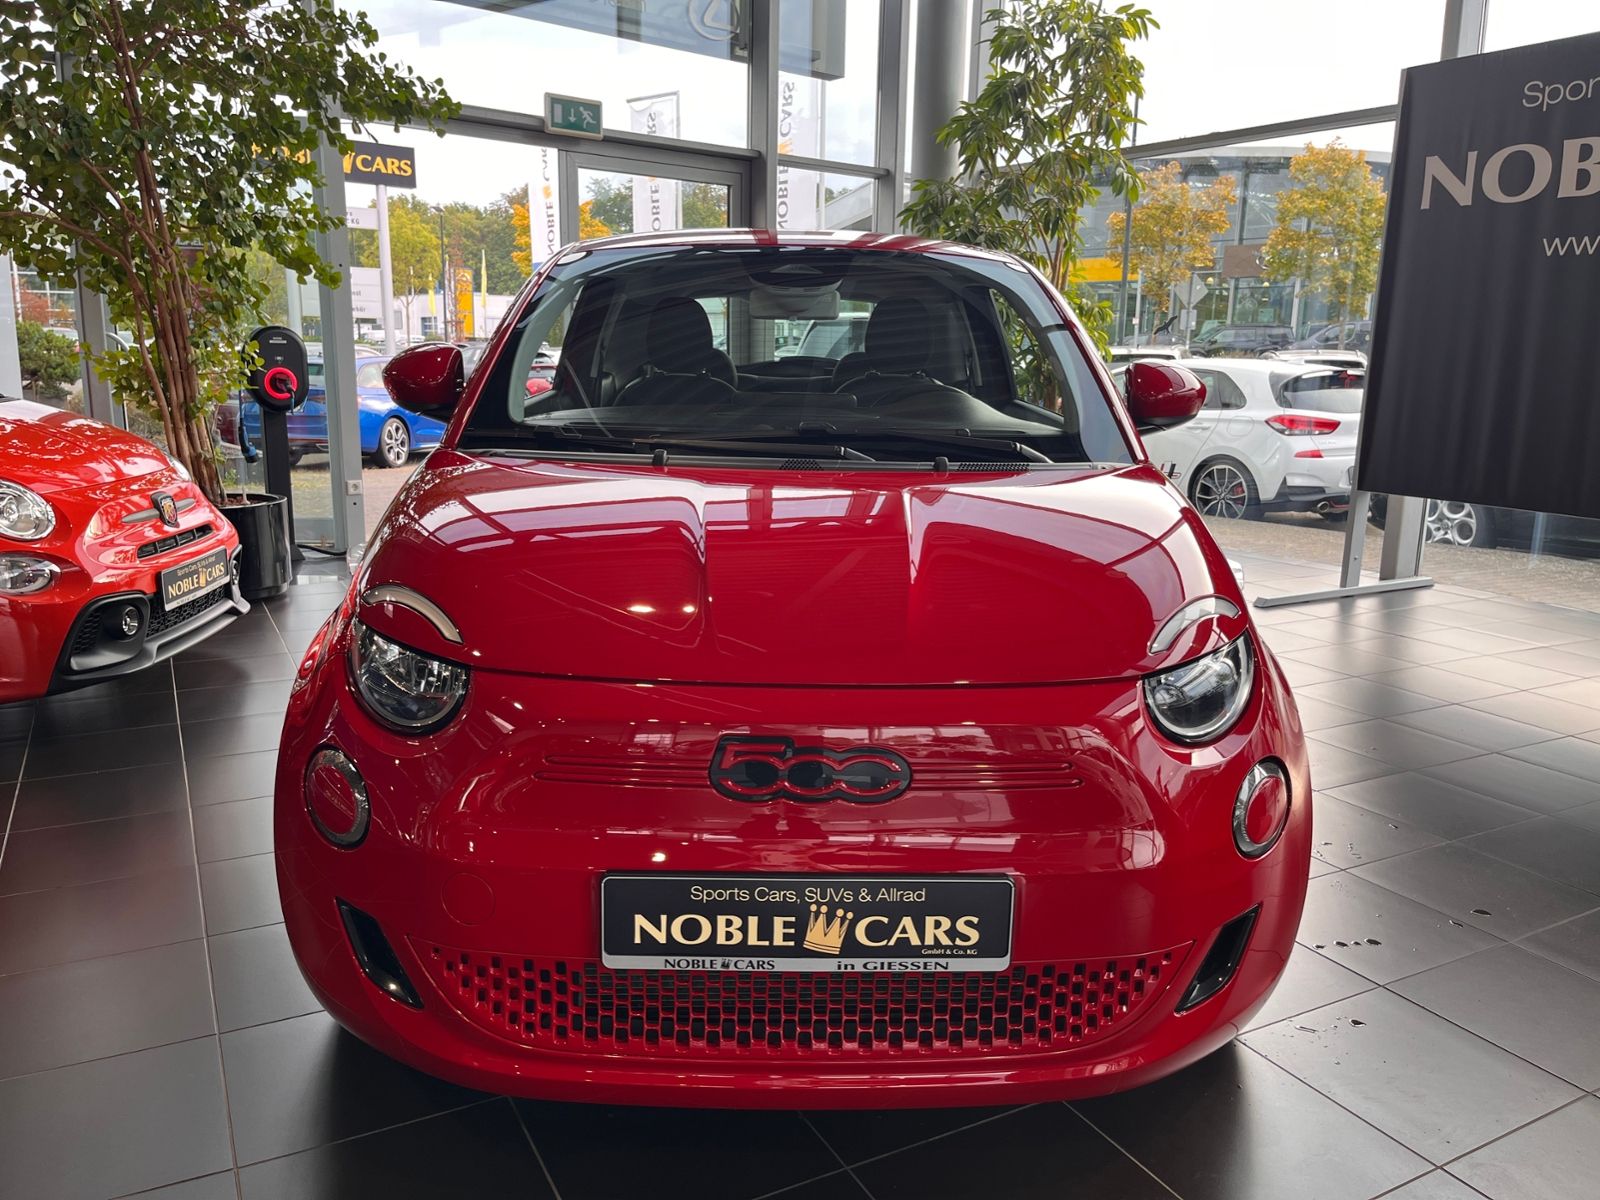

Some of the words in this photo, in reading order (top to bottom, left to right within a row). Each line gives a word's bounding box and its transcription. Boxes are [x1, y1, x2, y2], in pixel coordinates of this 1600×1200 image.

[355, 154, 413, 177] CARS
[1420, 136, 1600, 210] NOB
[168, 574, 199, 599] NOBLE
[206, 562, 225, 581] CARS
[713, 740, 907, 800] 500
[690, 885, 750, 903] Sports
[754, 886, 801, 904] Cars,
[804, 887, 853, 903] SUVs
[858, 888, 872, 902] &
[876, 887, 926, 902] Allrad
[634, 914, 796, 946] NOBLE
[854, 915, 980, 947] CARS
[664, 958, 718, 970] NOBLE
[733, 959, 775, 970] CARS
[837, 961, 855, 970] in
[862, 961, 949, 971] GIESSEN
